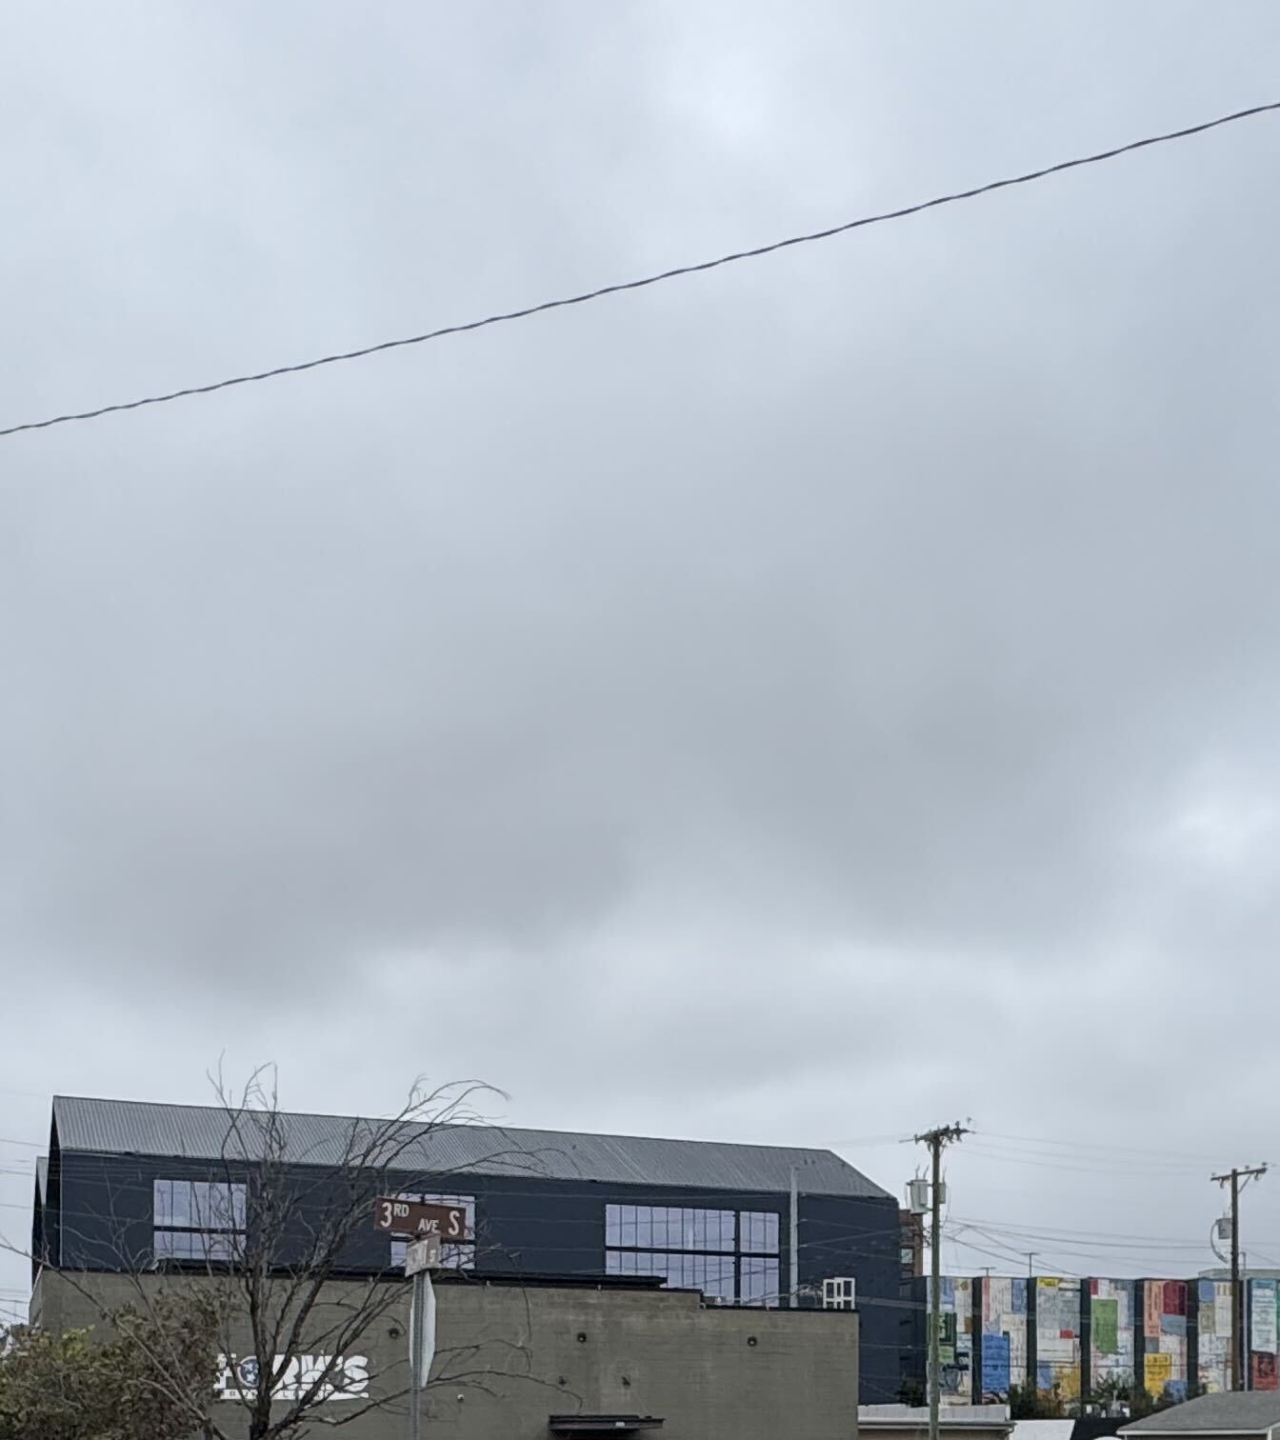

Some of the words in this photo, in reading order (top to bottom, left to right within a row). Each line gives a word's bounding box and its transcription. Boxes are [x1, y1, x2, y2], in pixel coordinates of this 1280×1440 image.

[380, 1202, 410, 1228] 3RD
[418, 1218, 439, 1234] AVE
[448, 1210, 461, 1236] S
